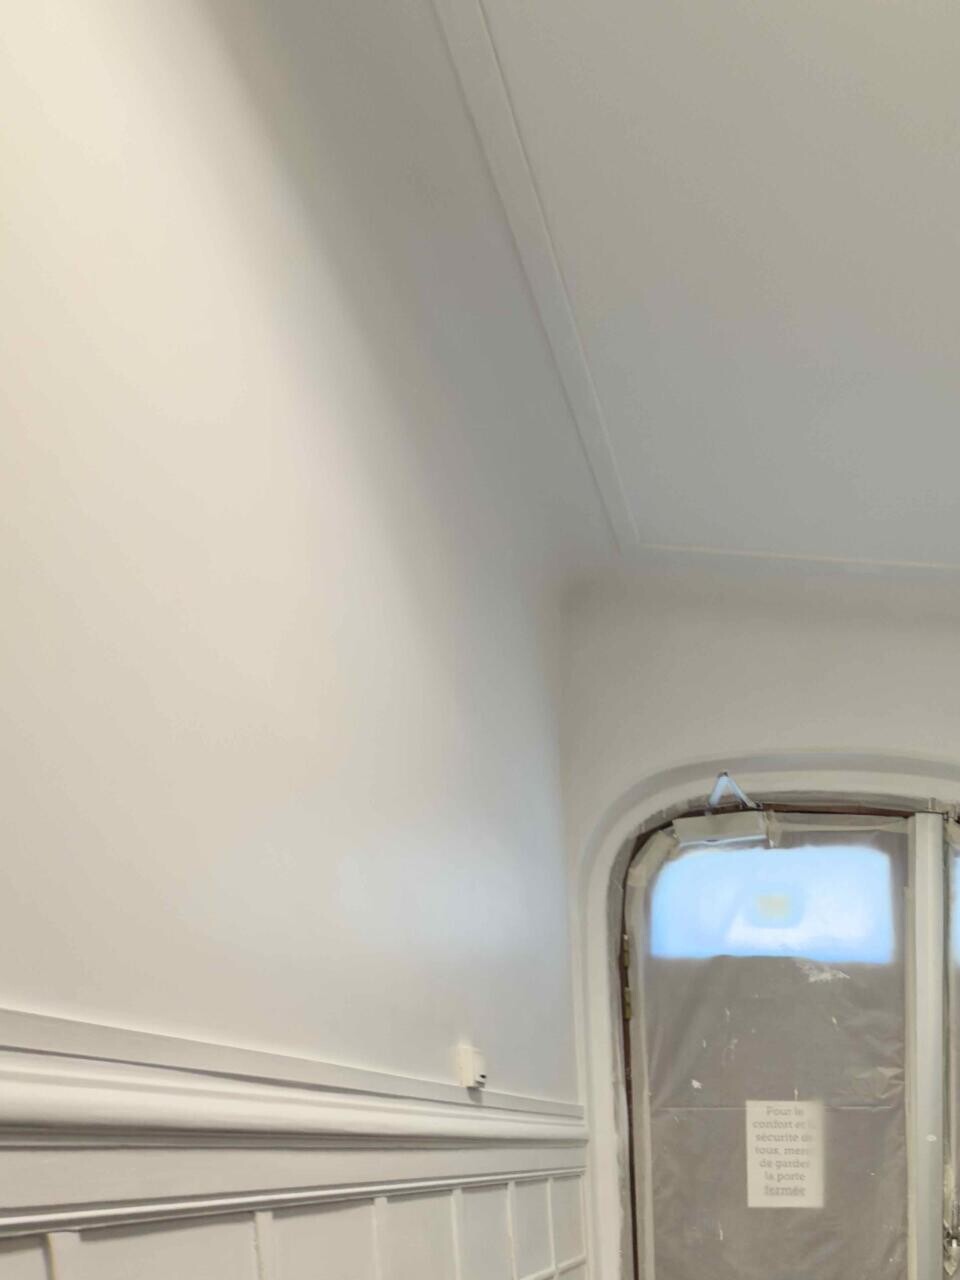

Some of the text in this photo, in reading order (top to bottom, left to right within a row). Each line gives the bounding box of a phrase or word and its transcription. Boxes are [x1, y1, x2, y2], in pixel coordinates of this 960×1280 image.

[766, 1106, 804, 1116] Pour le
[752, 1120, 792, 1129] confort
[760, 1159, 772, 1168] de
[765, 1171, 806, 1182] la porte
